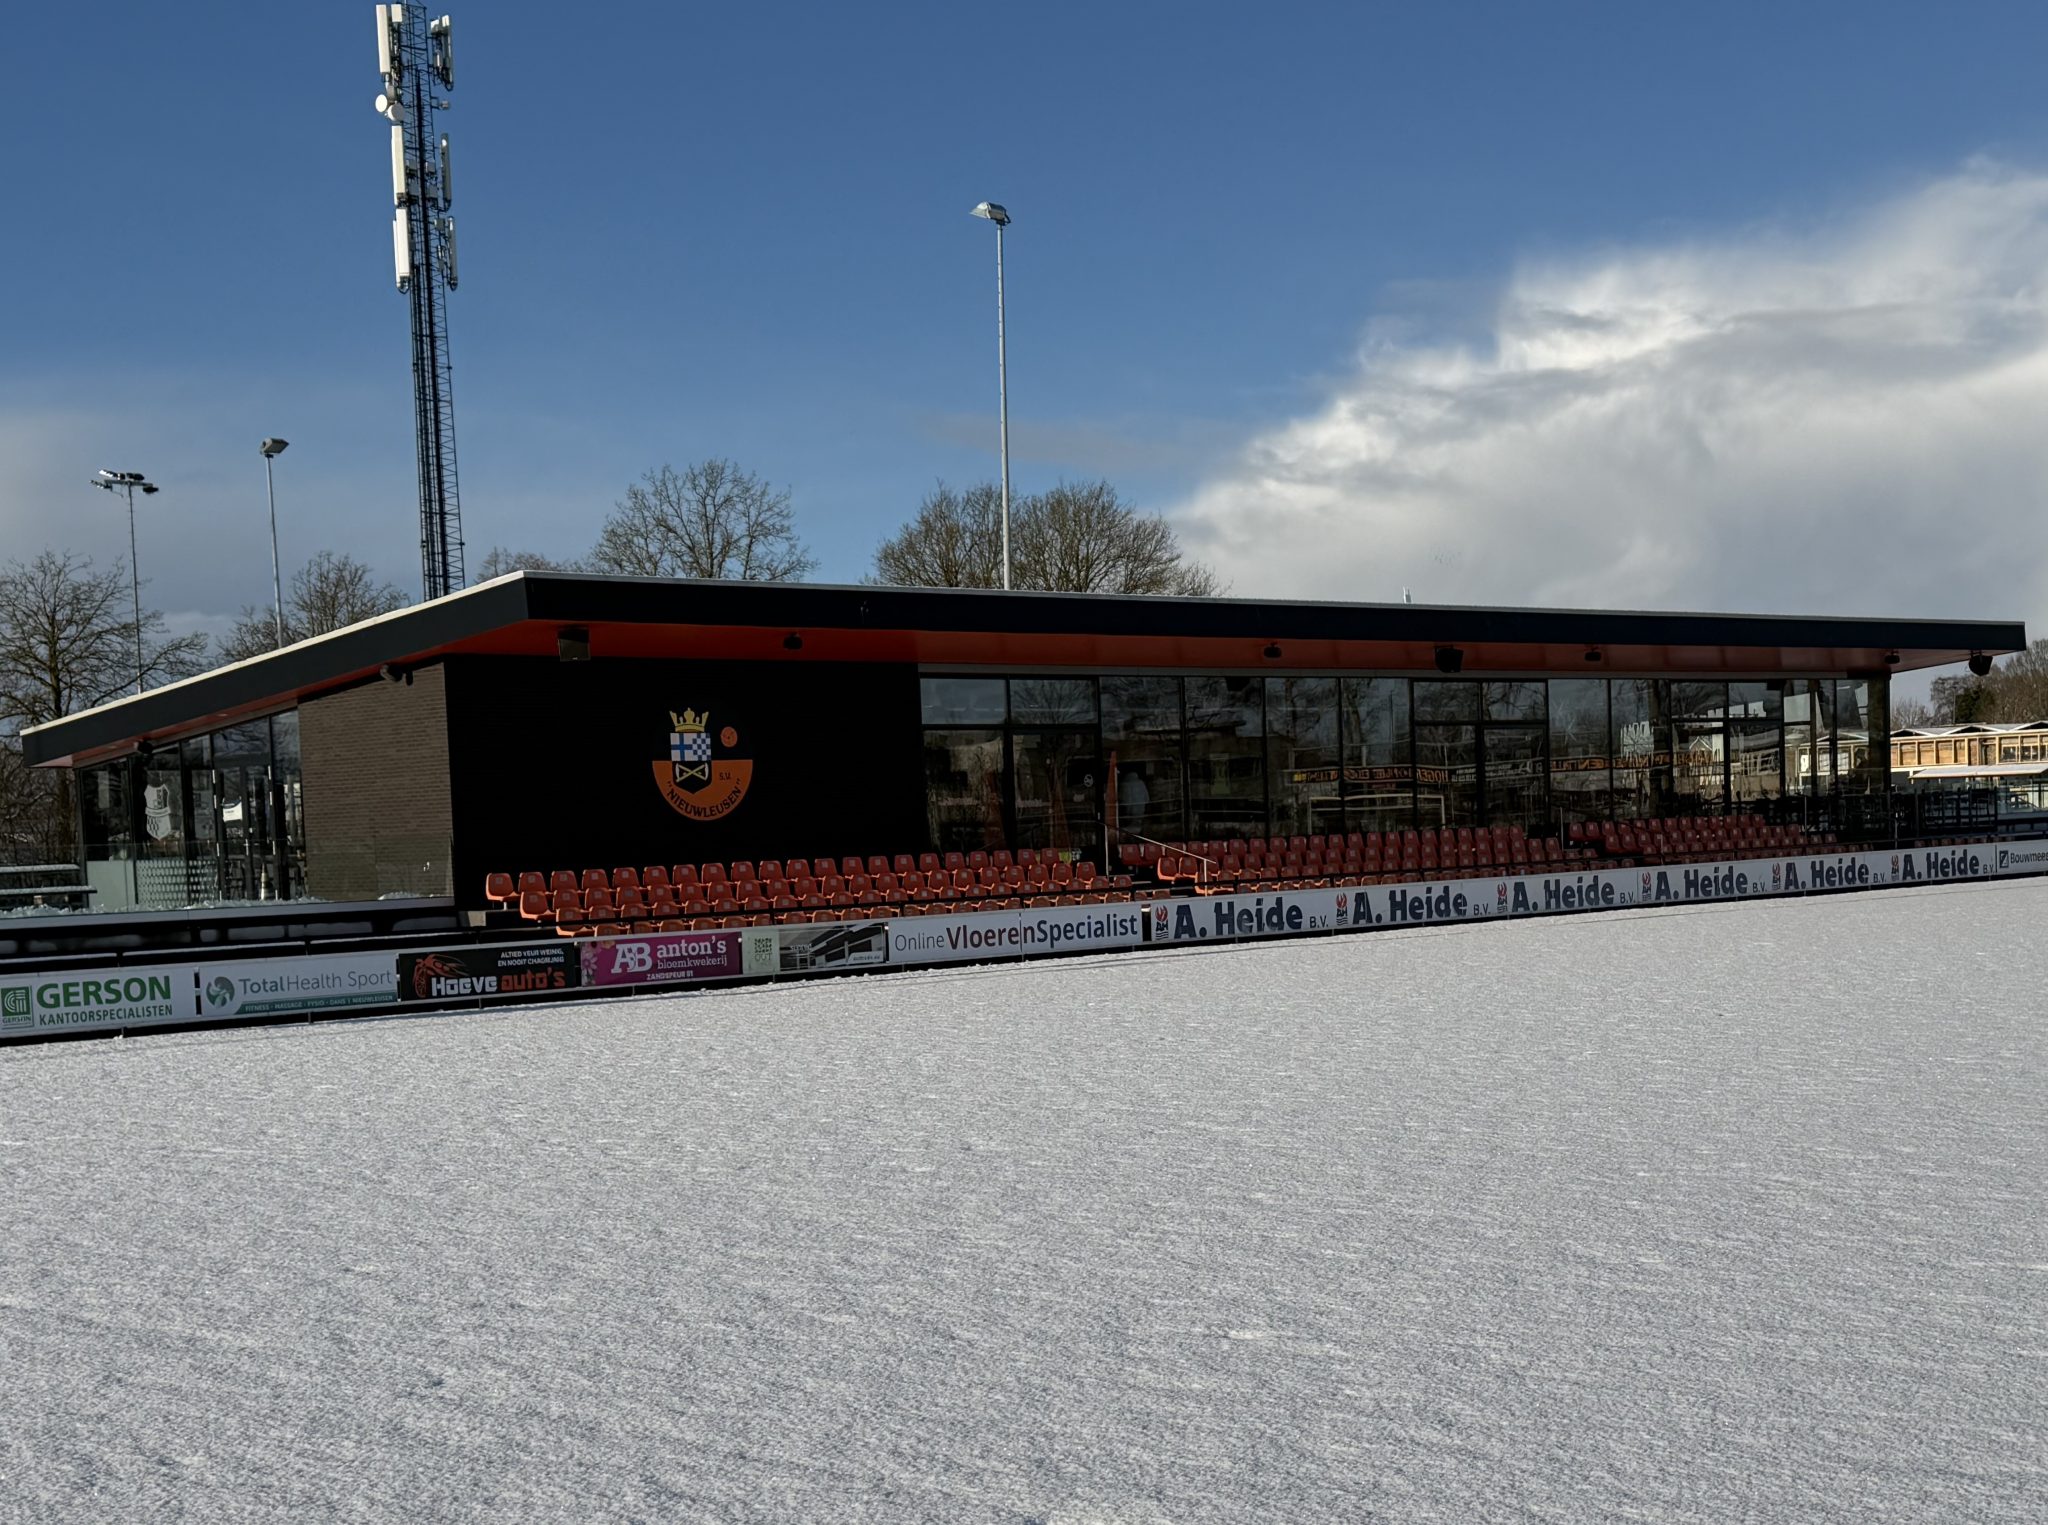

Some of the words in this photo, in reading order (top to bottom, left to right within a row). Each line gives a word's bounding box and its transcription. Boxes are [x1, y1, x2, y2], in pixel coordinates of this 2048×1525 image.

[1784, 862, 1807, 890] A.
[1810, 857, 1870, 888] Heide
[1873, 872, 1887, 884] B.V.
[1902, 853, 1923, 881] A.
[1926, 848, 1980, 879] Heide
[1982, 864, 1995, 875] B.V.
[1511, 881, 1539, 913] A.
[1543, 874, 1615, 910] Heide
[1619, 891, 1637, 904] B.V.
[1655, 871, 1680, 900] A.
[1683, 865, 1748, 898] Heide
[1752, 881, 1768, 893] B.V.
[1174, 904, 1208, 939] A.
[1213, 896, 1303, 936] Heide
[1309, 915, 1329, 929] B.V.
[1352, 891, 1383, 925] A.
[1388, 885, 1468, 922] Heide
[1473, 903, 1491, 917] B.V.
[656, 935, 727, 959] anton's
[507, 958, 527, 967] NOOIT
[657, 954, 728, 970] bloemkwekerij
[36, 975, 172, 1009] GERSON
[347, 968, 393, 989] Sport
[501, 967, 566, 991] auto's
[39, 1004, 173, 1026] KANTOORSPECIALISTEN
[245, 1004, 270, 1012] FITNESS
[307, 999, 325, 1007] FYSIO
